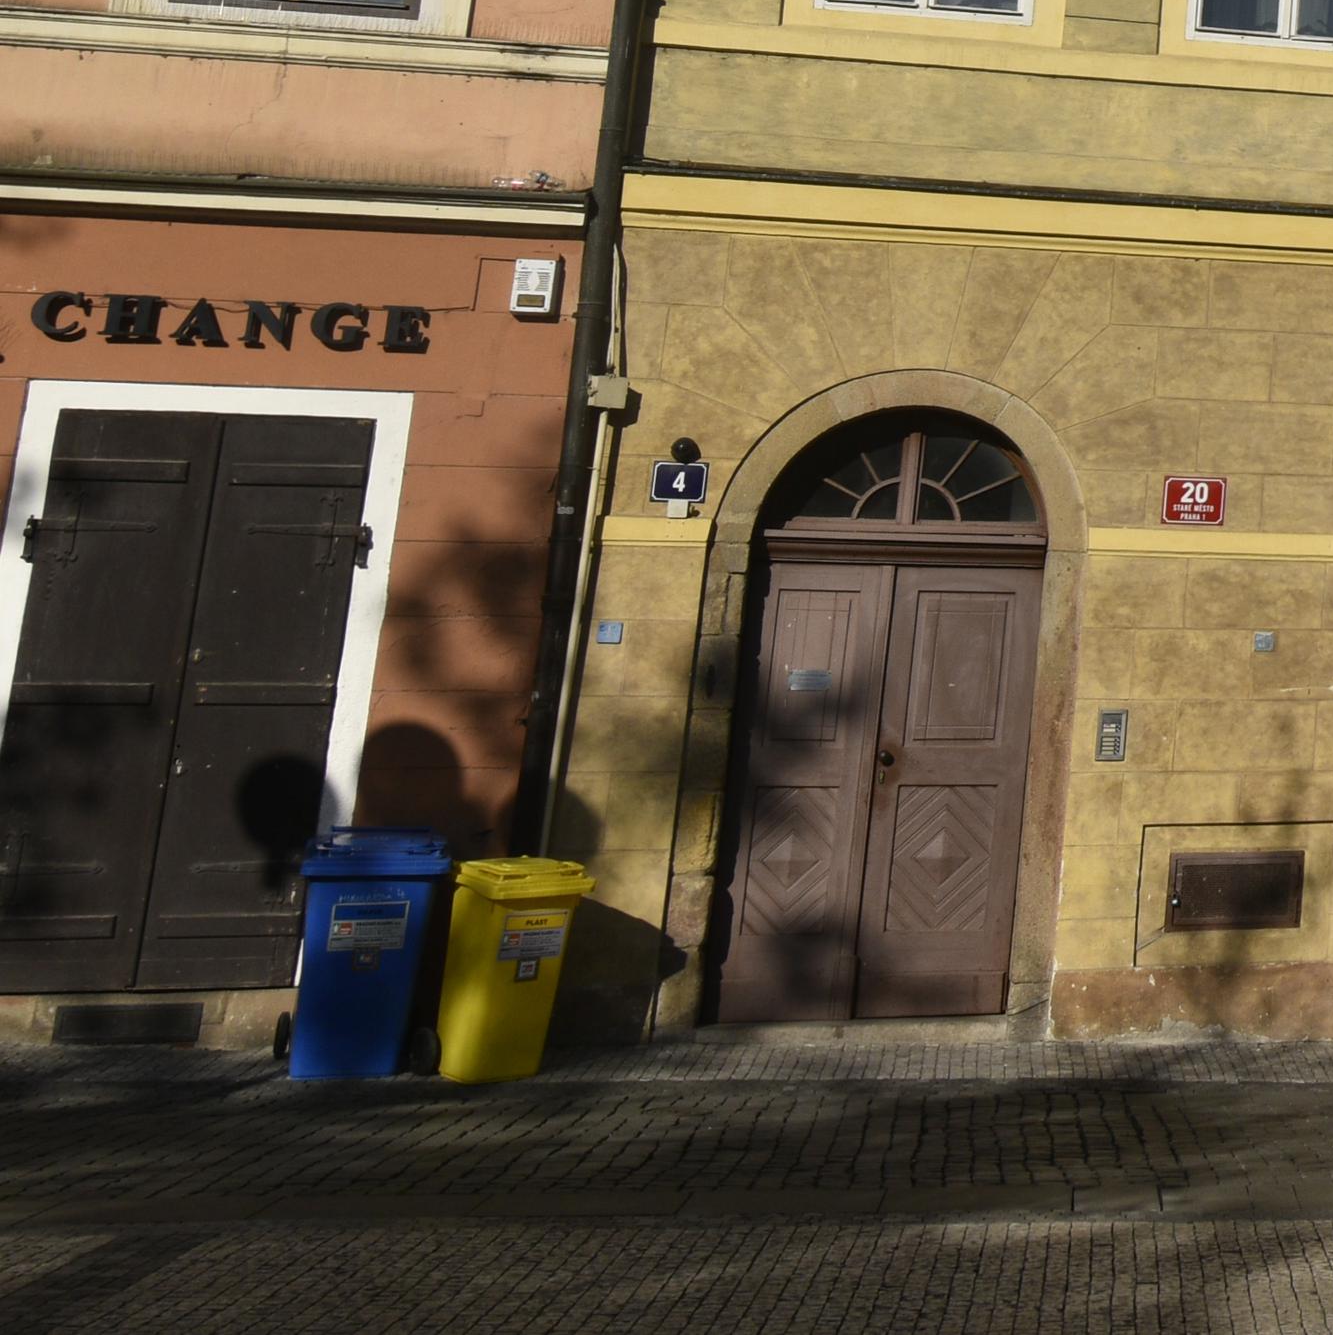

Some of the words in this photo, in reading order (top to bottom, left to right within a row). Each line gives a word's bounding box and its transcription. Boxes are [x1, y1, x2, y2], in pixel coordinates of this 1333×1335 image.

[31, 291, 429, 352] CHANGE
[672, 471, 686, 493] 4
[1180, 482, 1209, 504] 20
